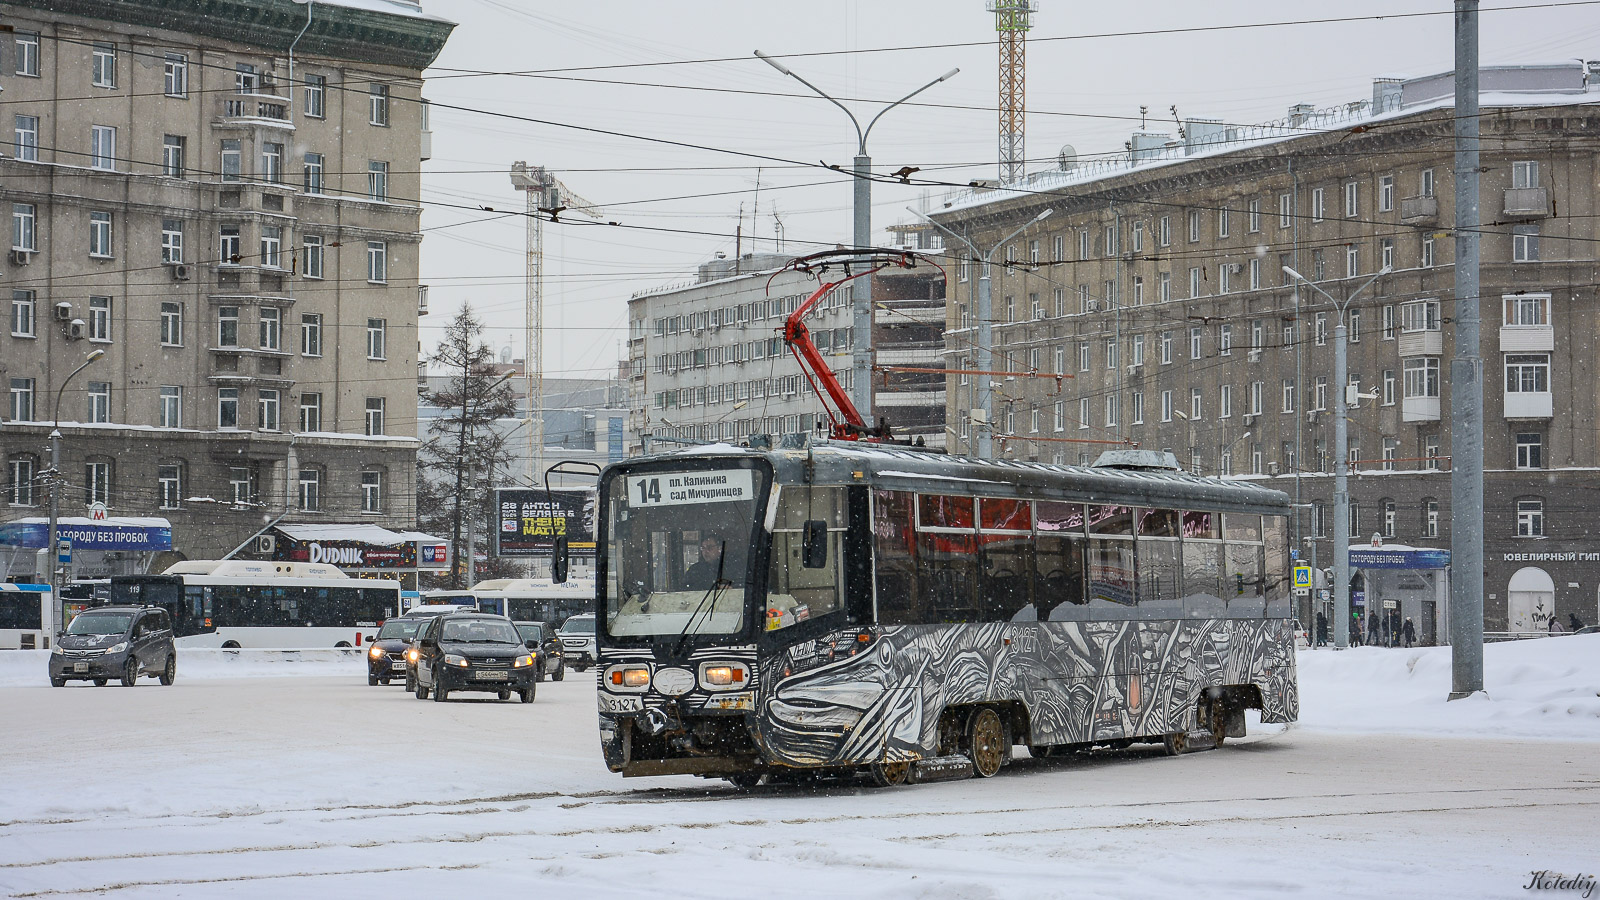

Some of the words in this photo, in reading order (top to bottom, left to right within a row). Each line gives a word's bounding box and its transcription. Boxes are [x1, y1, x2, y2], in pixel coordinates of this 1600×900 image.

[637, 478, 662, 504] 14
[669, 479, 683, 488] пл.
[684, 475, 727, 487] Калинина
[670, 491, 687, 501] сад
[688, 487, 743, 500] Мичуринцев
[501, 502, 517, 510] 28
[522, 502, 560, 510] АНТОН
[97, 531, 114, 542] БЕЗ
[115, 531, 149, 543] ПРОБОК
[1503, 552, 1576, 561] ЮВЕЛИРНЫЙ
[129, 585, 140, 594] 119
[1012, 626, 1039, 654] 3127
[609, 698, 637, 711] 3127
